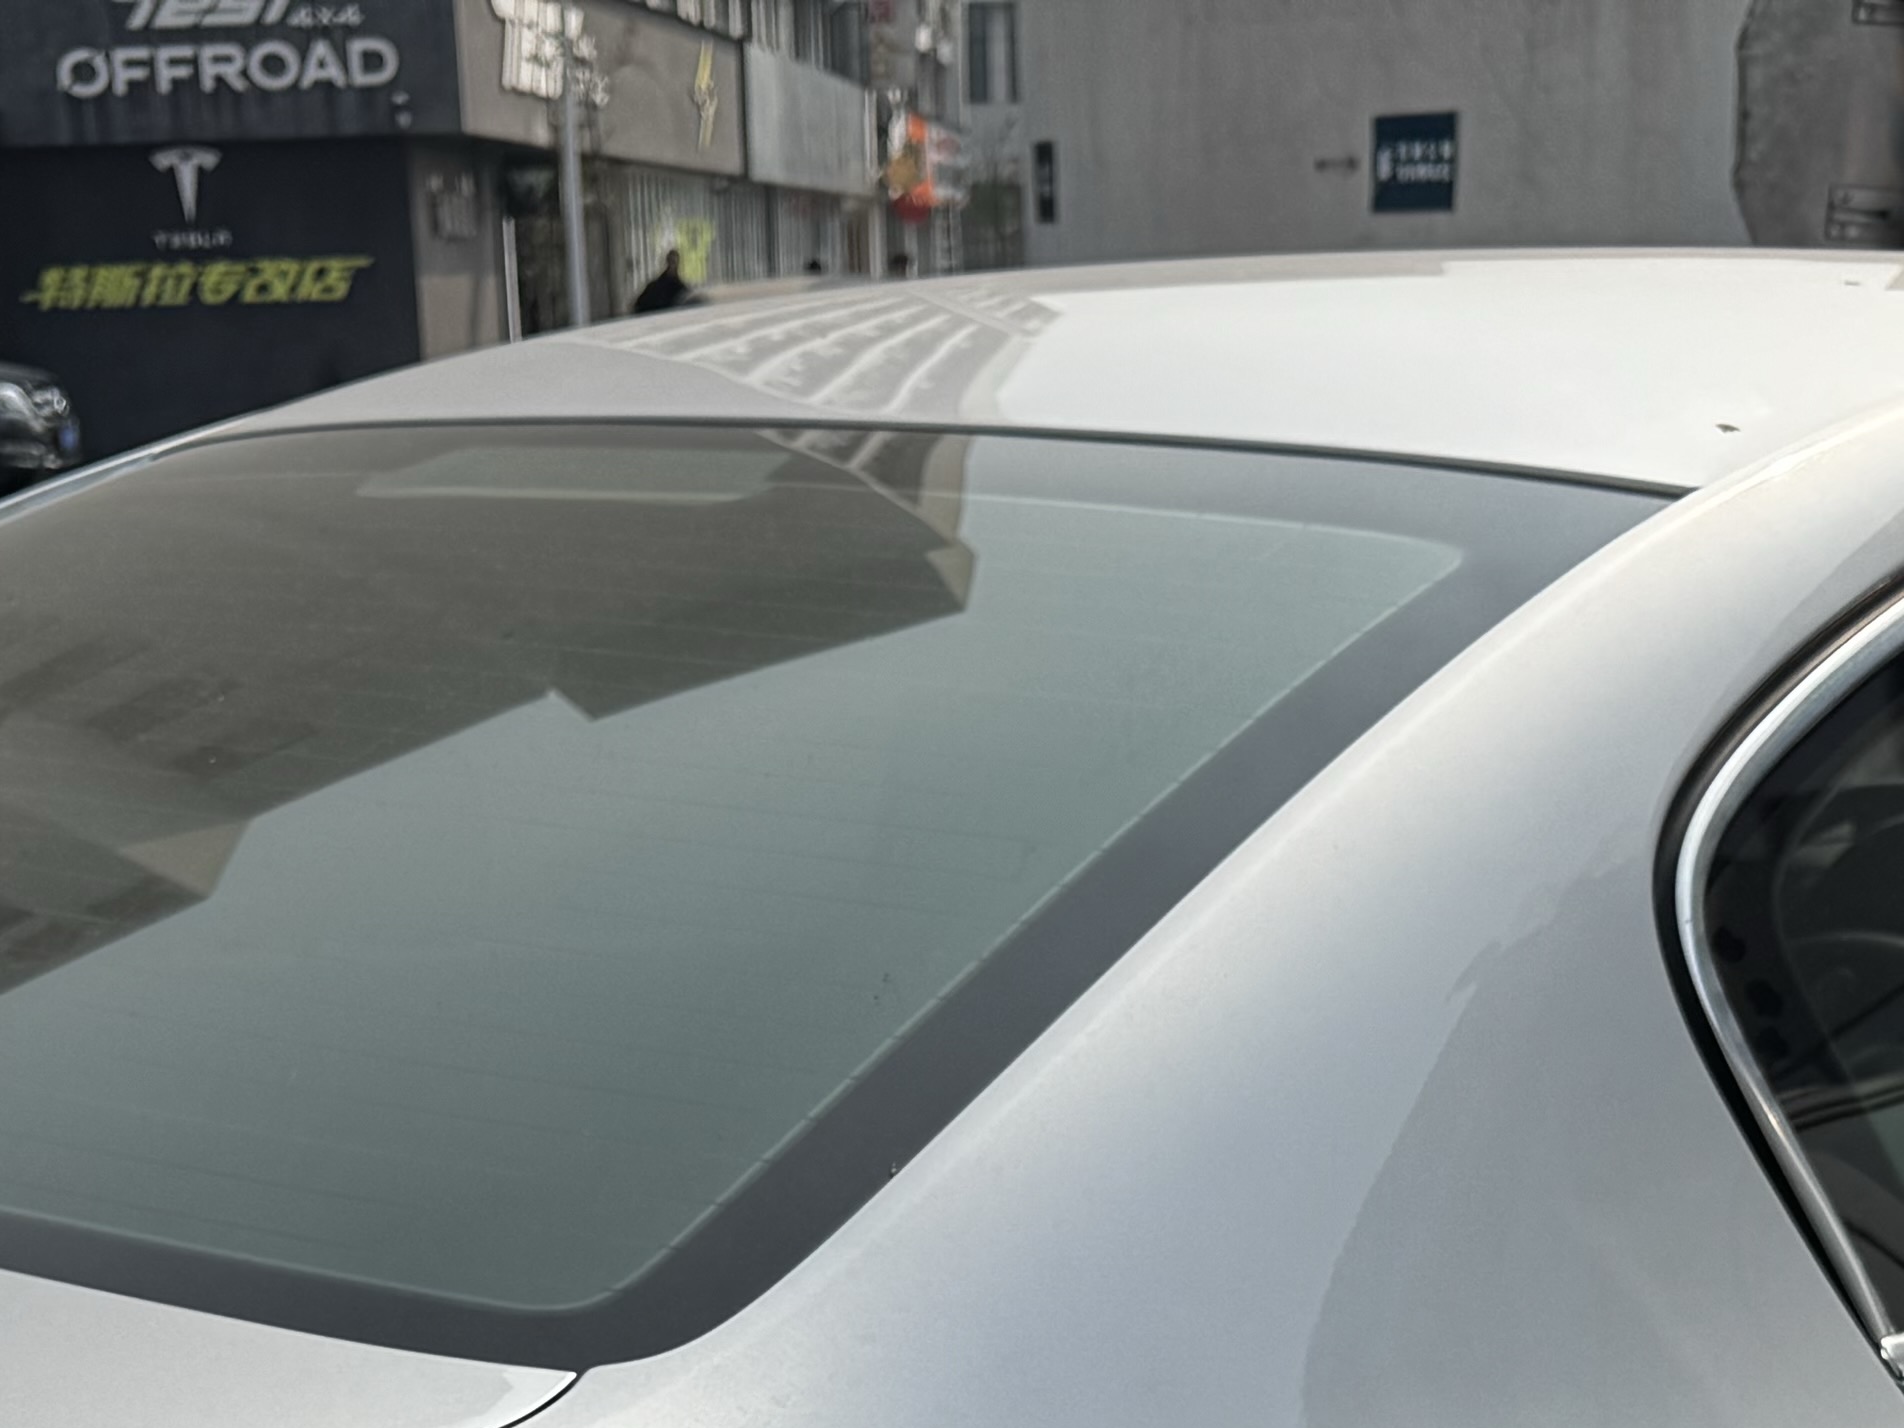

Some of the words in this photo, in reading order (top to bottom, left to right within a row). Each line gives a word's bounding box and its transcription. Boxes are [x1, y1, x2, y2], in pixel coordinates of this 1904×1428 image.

[56, 36, 398, 98] OFFROAD
[20, 254, 375, 310] 特斯拉专改店
